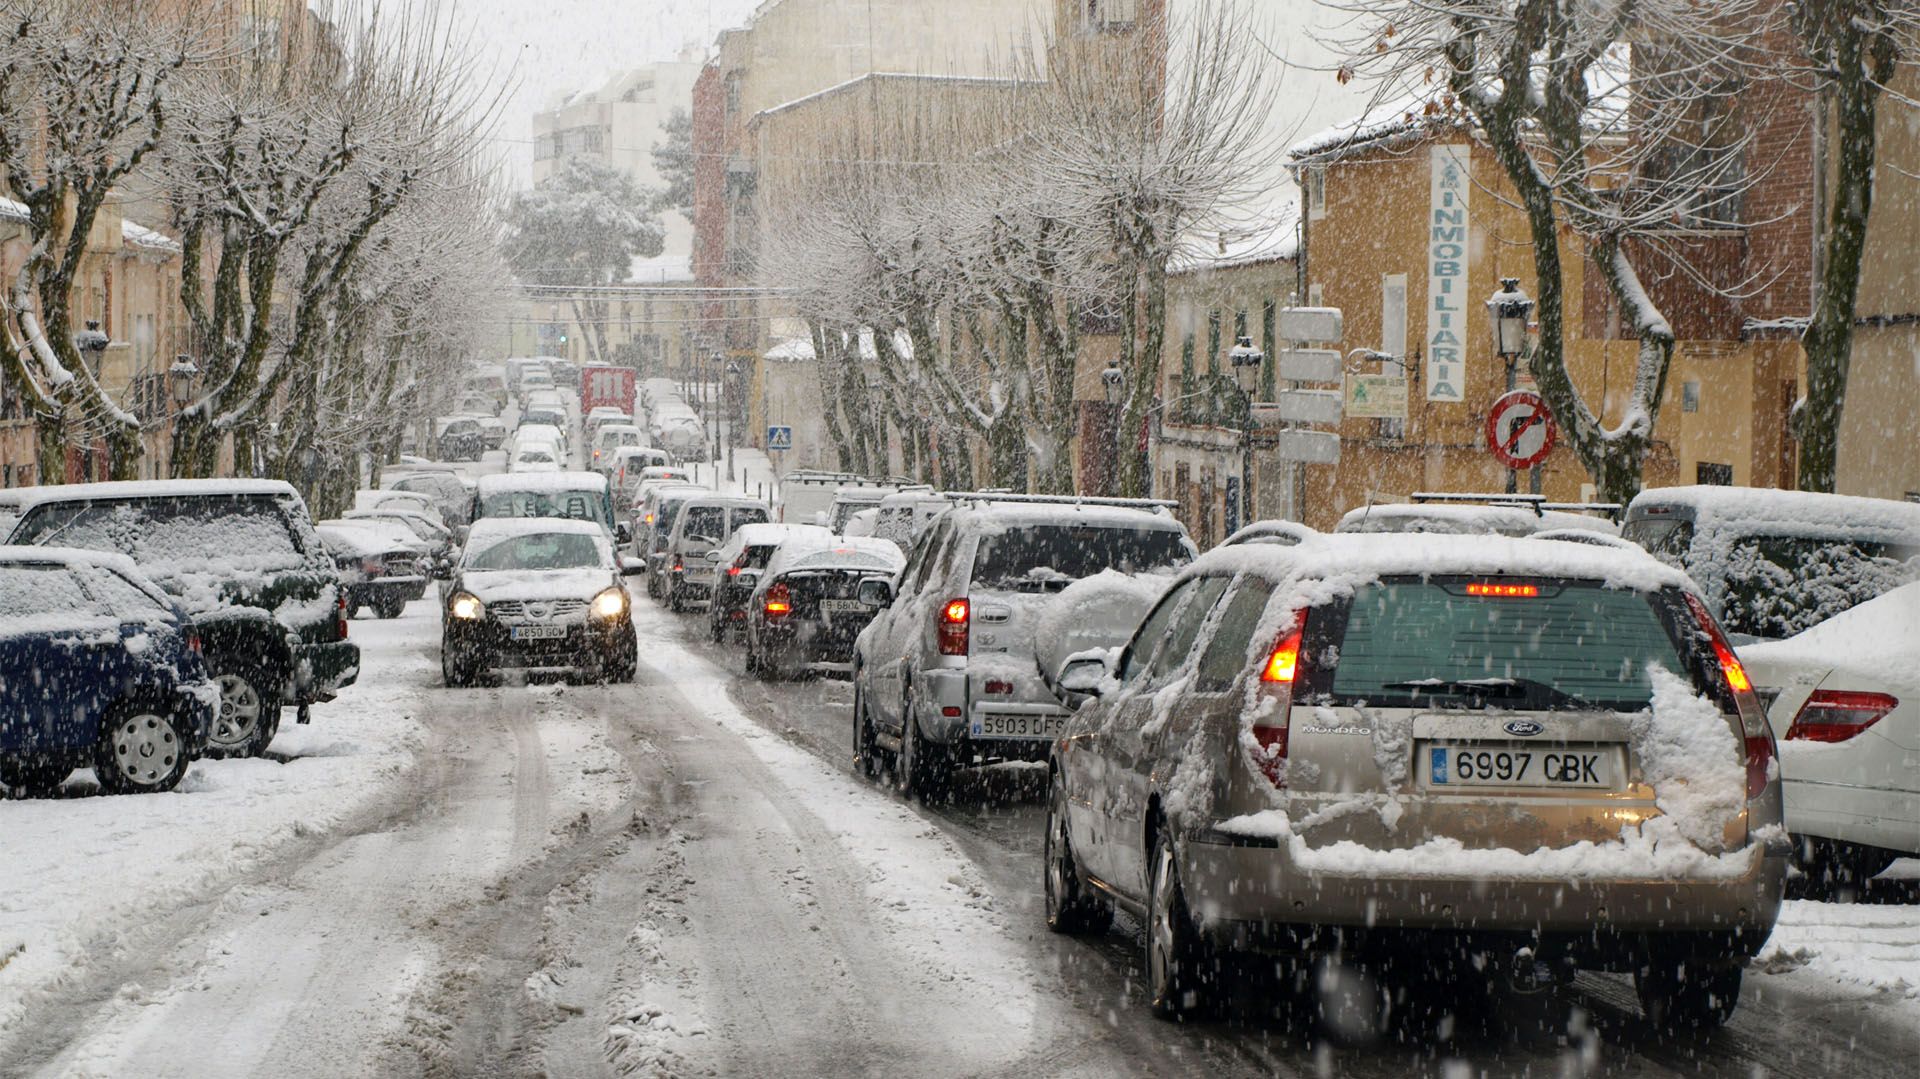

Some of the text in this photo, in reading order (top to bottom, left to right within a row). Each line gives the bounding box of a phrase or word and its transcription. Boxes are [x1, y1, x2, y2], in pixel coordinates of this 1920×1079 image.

[1430, 191, 1465, 397] INMOBILIARIA
[984, 717, 1028, 734] 5903
[1303, 726, 1371, 735] MONDEO
[1511, 721, 1534, 732] Ford
[1456, 752, 1599, 783] 6997 CBK
